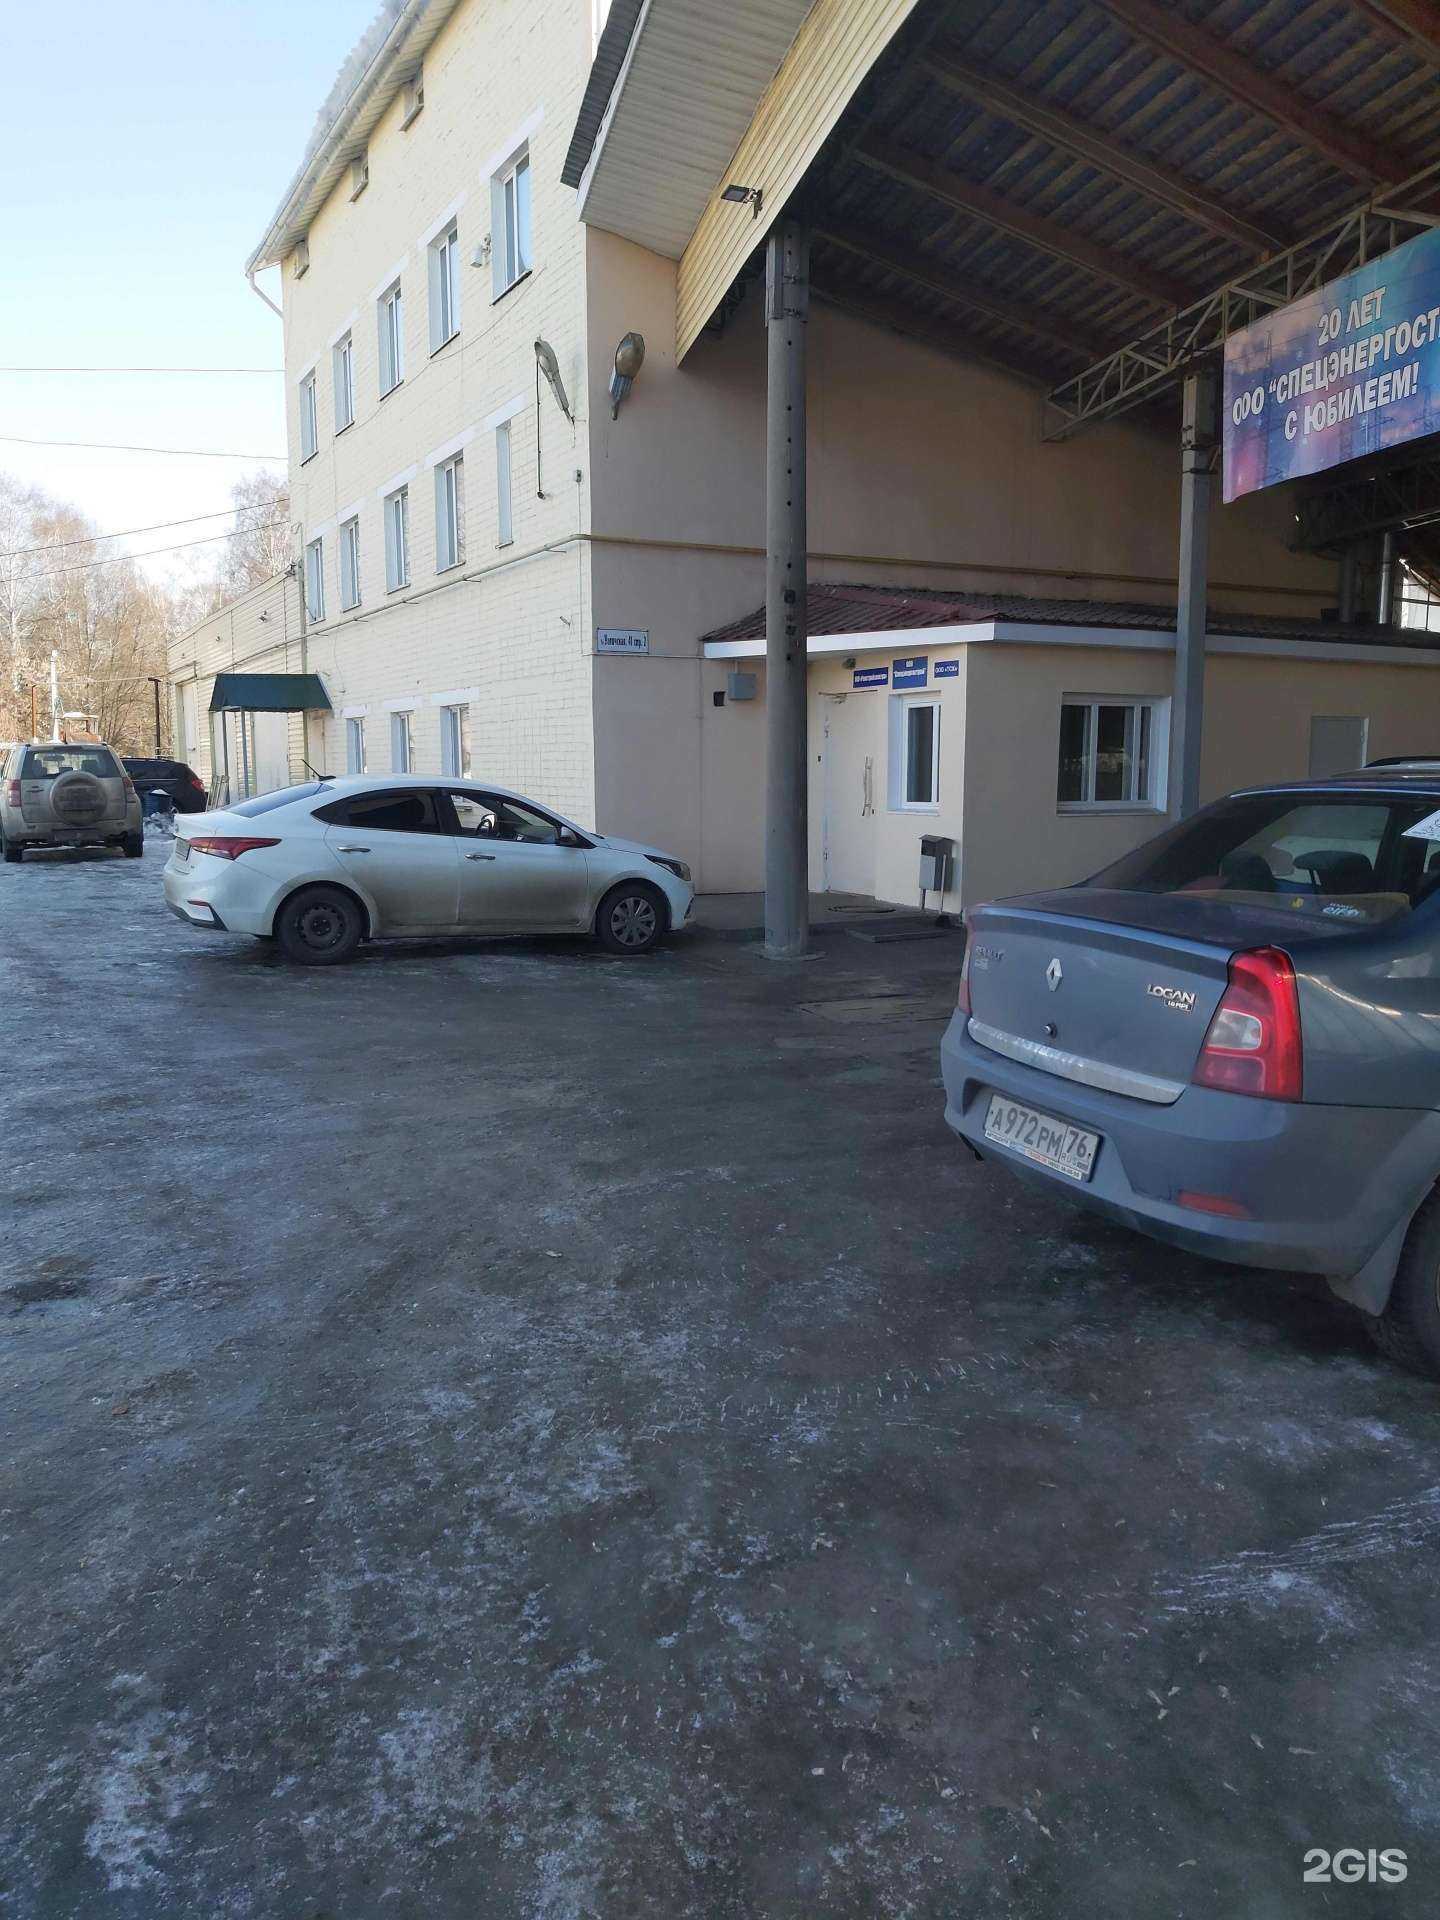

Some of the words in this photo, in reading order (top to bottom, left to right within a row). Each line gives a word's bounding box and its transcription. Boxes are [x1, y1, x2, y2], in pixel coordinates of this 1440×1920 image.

[1318, 308, 1342, 346] 20
[1346, 287, 1386, 333] ЛЕТ
[1232, 386, 1265, 426] ООО
[1269, 306, 1440, 404] “СПЕЦЭНЕРГОСТ
[1284, 410, 1297, 441] С
[1303, 361, 1420, 435] ЮБИЛЕЕМ!
[1146, 983, 1196, 1004] LOGAN
[1066, 1129, 1089, 1159] 76
